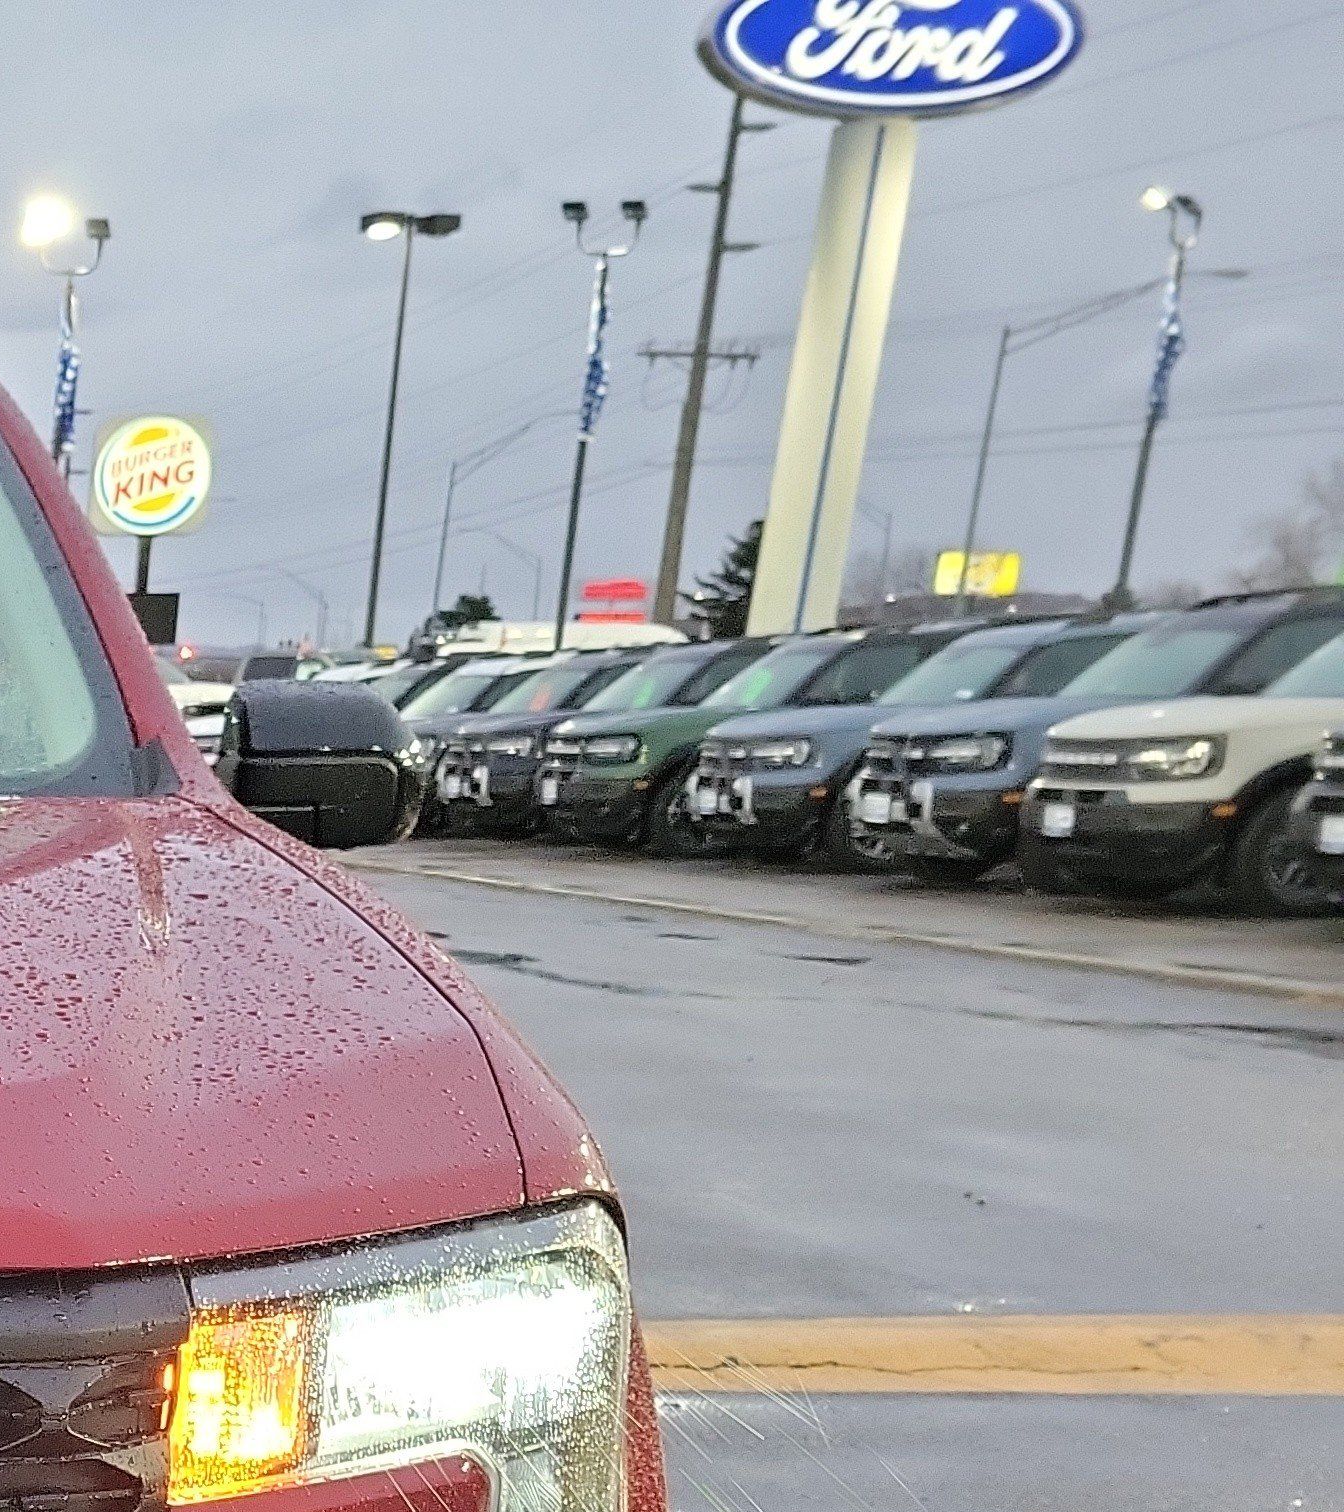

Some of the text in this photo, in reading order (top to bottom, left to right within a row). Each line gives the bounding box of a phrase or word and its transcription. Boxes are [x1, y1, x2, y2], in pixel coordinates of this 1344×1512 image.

[785, 0, 1018, 83] Ford
[111, 440, 194, 478] BURGER
[113, 460, 196, 507] KING
